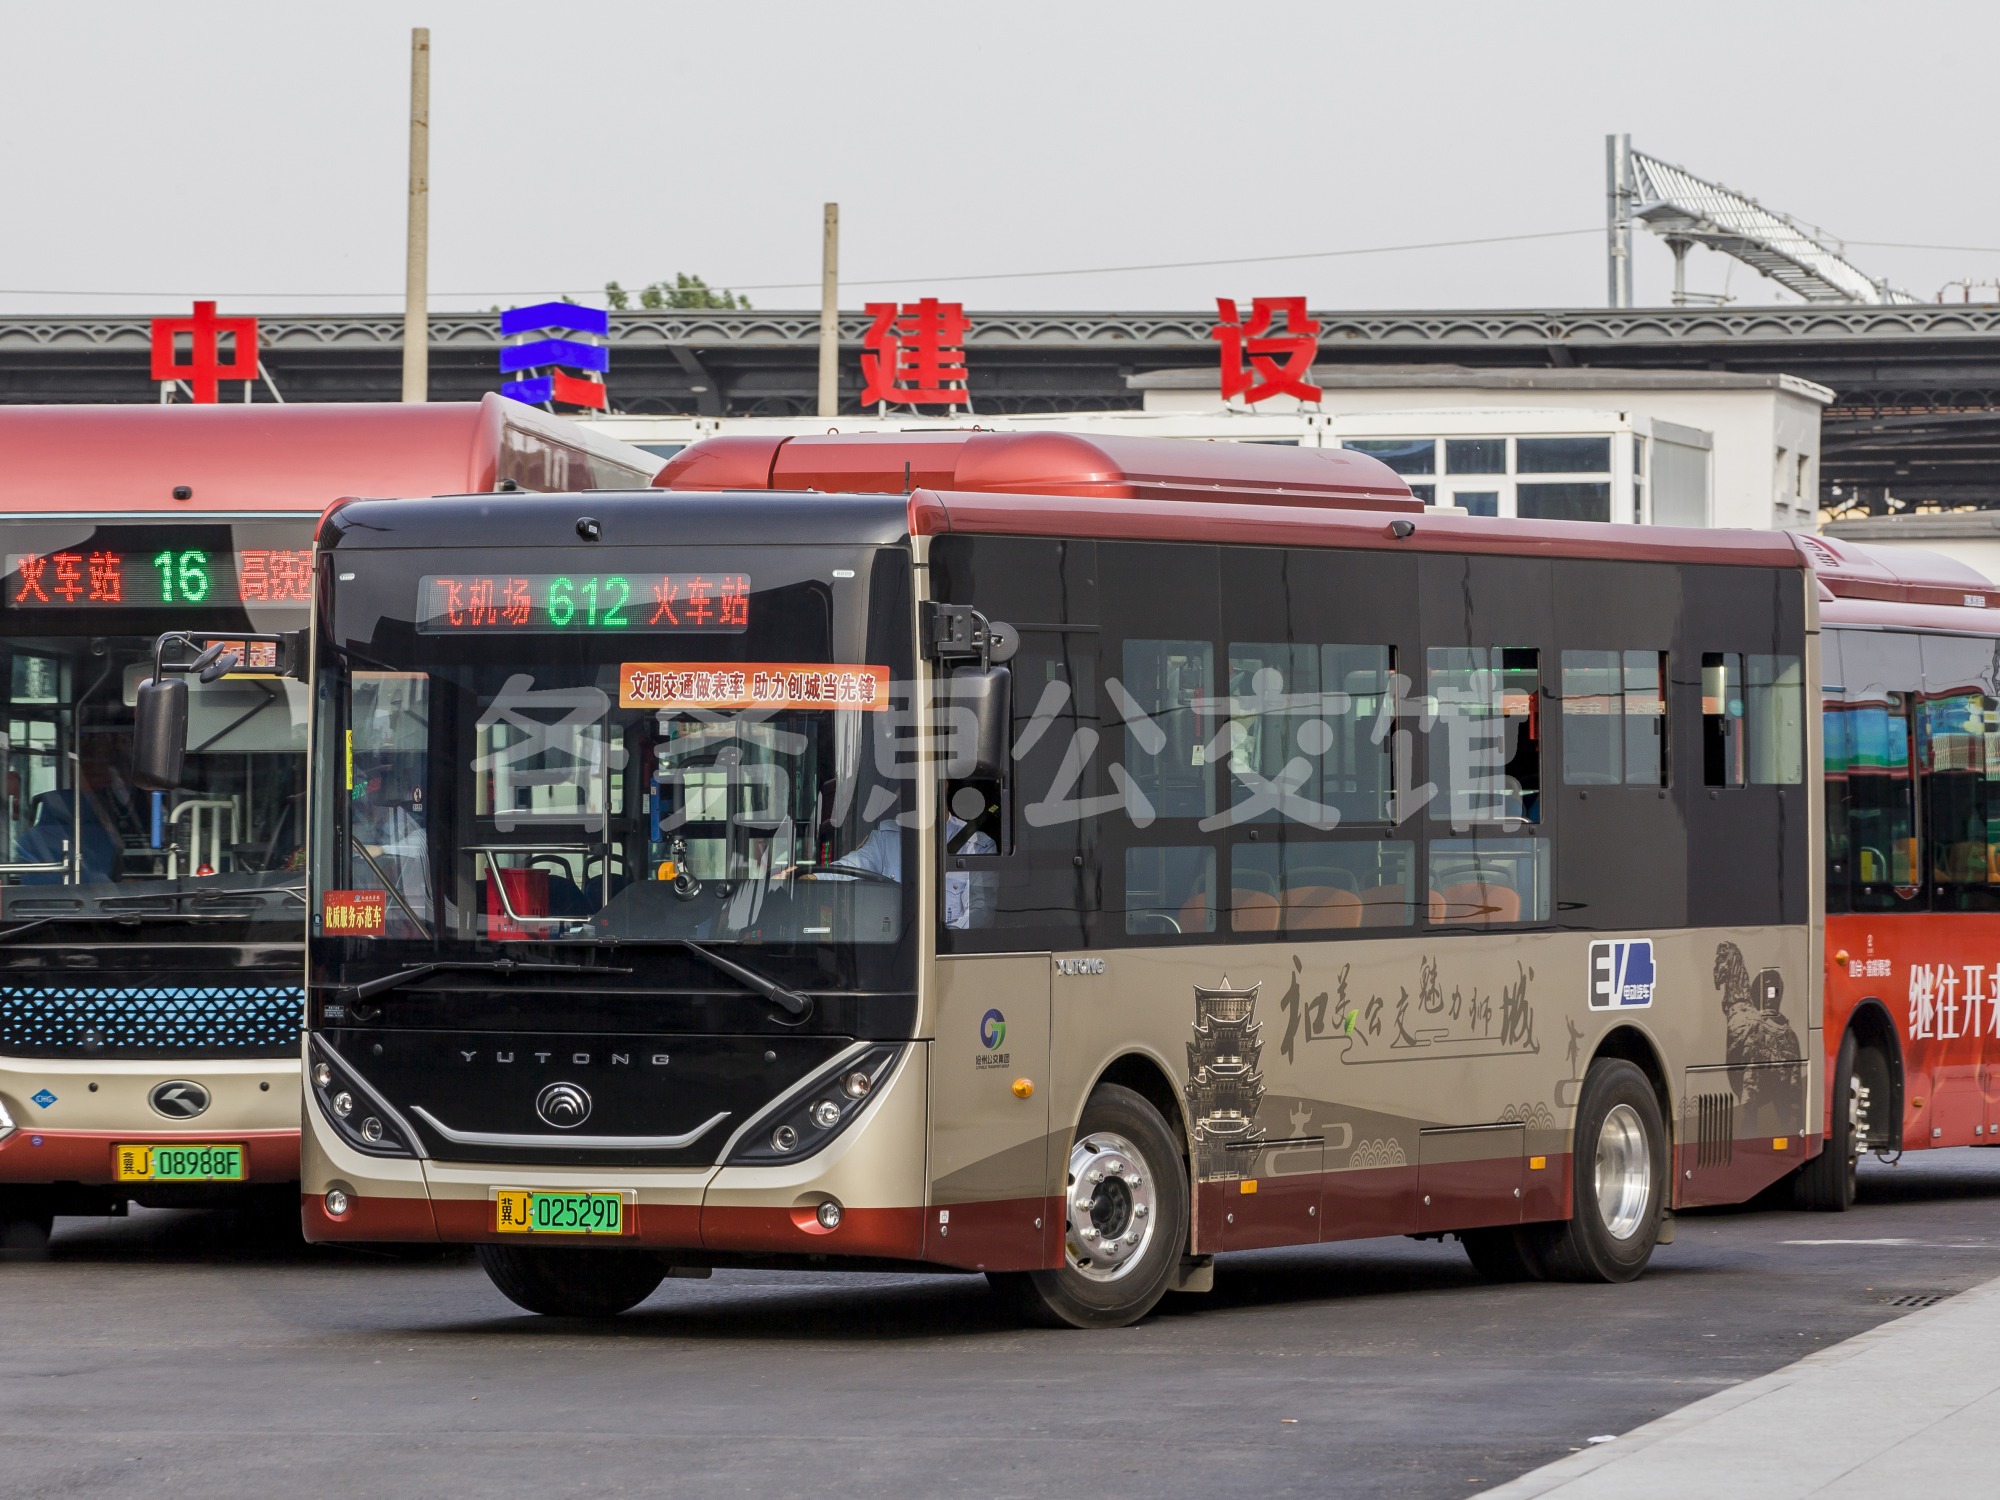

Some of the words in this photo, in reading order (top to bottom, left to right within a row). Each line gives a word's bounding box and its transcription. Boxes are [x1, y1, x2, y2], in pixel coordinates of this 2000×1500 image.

[151, 301, 259, 403] 中
[16, 553, 121, 602] 火车站
[154, 551, 209, 602] 16
[436, 578, 531, 625] 飞机场
[549, 577, 629, 625] 612
[649, 576, 749, 625] 火车站
[630, 671, 745, 701] 文明交通做表率
[753, 672, 876, 703] 助力创城当先锋
[325, 905, 382, 928] 优质服务示范车
[1055, 958, 1105, 976] YUTONG
[1590, 942, 1634, 1007] EV
[460, 1050, 670, 1066] YUTONG
